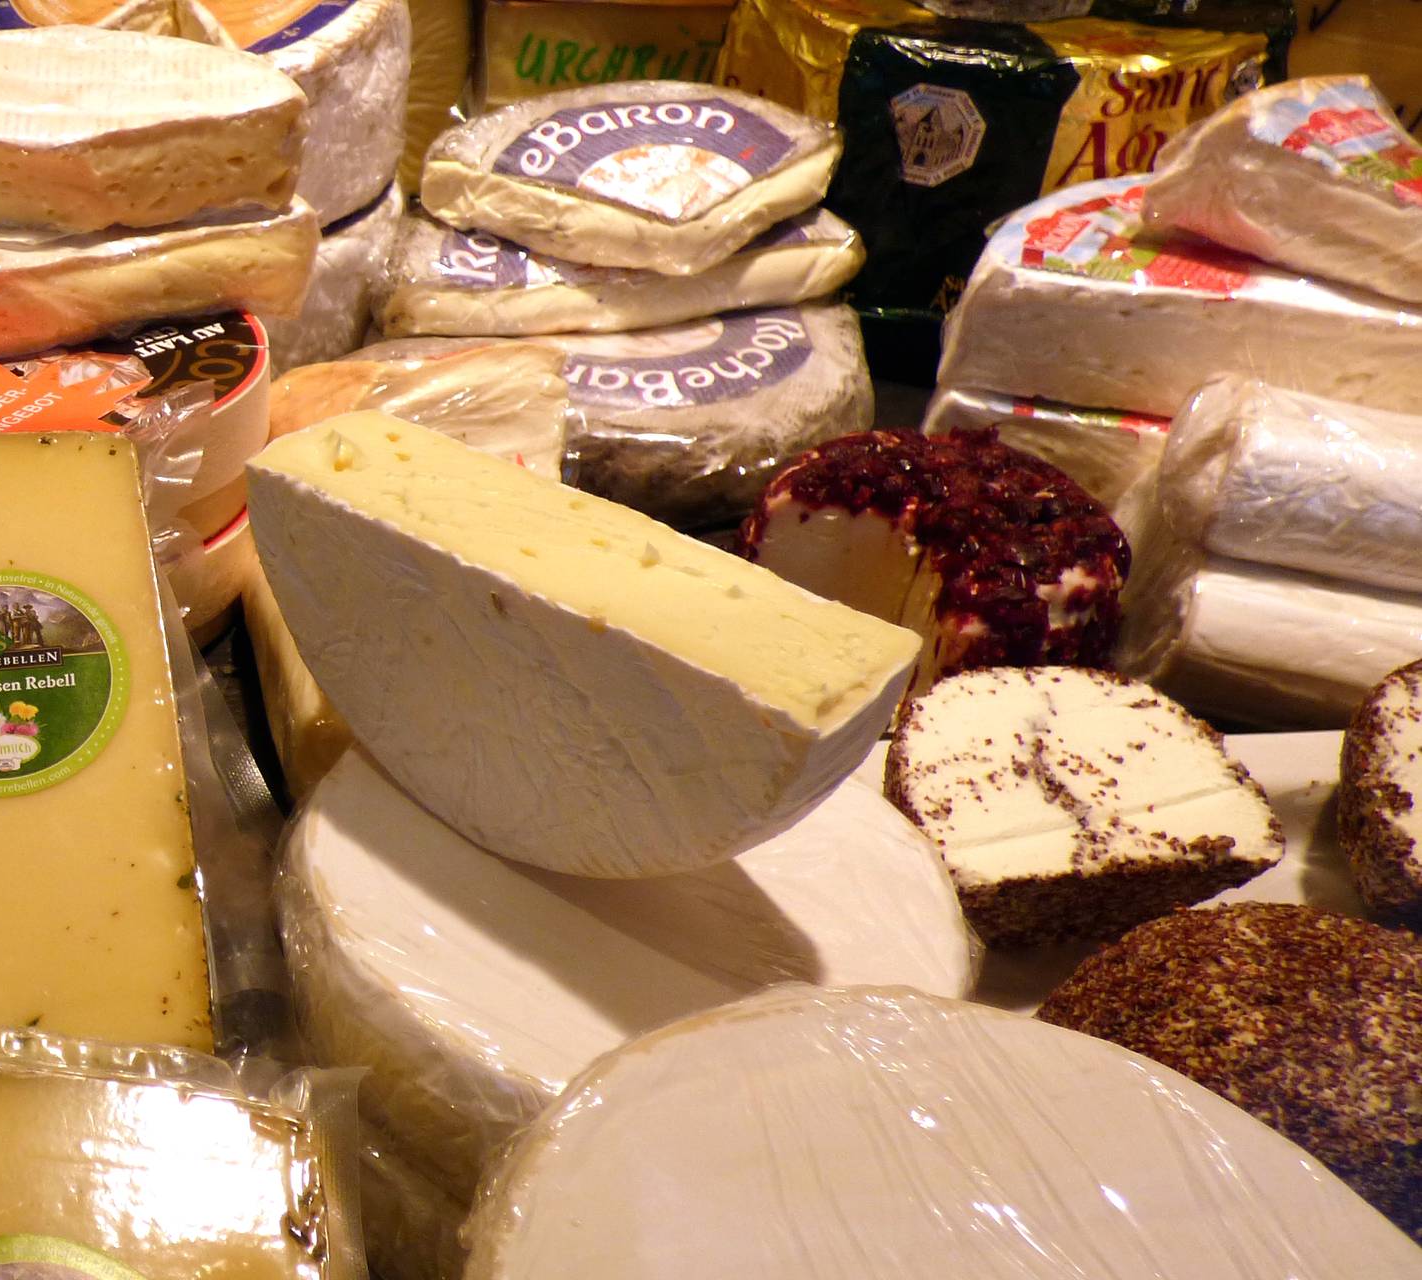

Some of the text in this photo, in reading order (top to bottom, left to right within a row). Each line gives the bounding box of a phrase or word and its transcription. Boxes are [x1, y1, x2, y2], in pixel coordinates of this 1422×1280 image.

[133, 322, 226, 358] AU LAIT
[24, 673, 77, 691] Rebell
